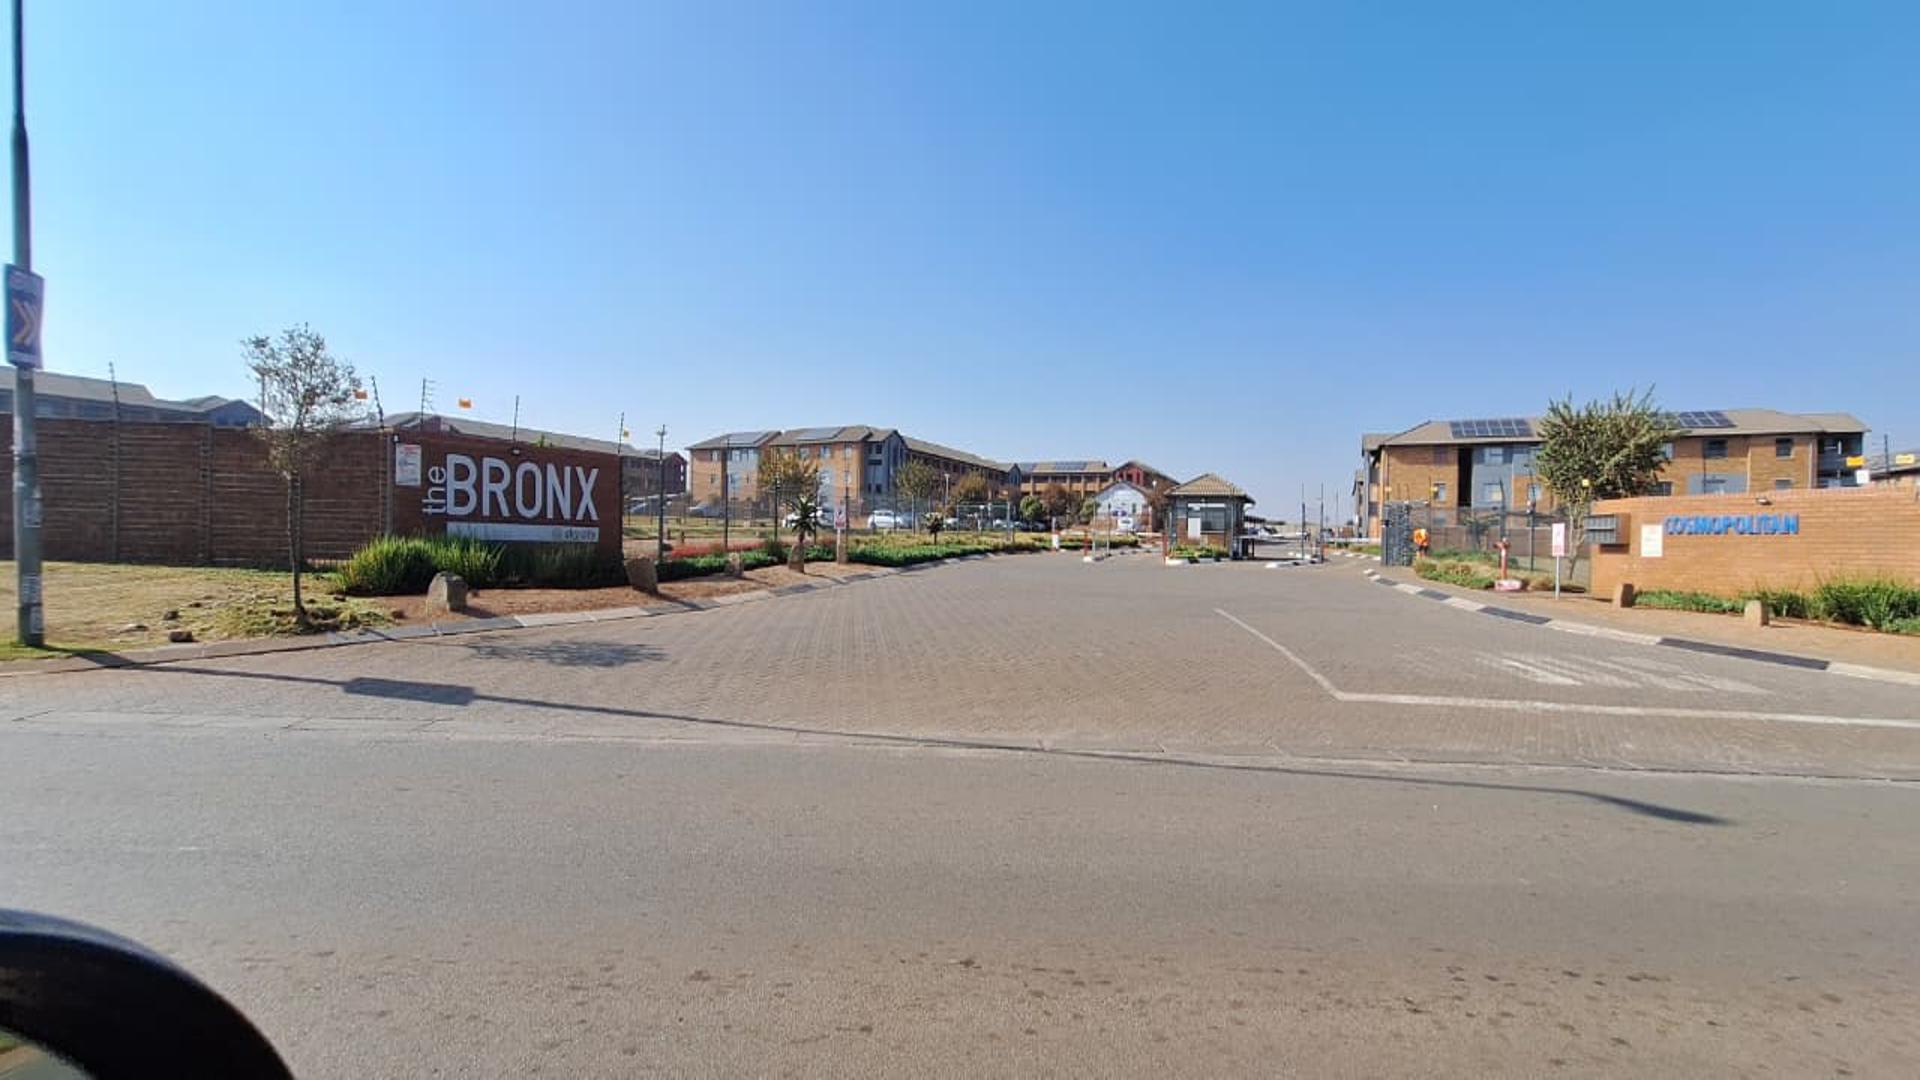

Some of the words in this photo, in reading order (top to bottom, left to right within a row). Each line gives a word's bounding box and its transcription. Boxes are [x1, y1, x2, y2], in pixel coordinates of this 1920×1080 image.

[421, 465, 447, 515] the
[446, 453, 600, 521] BRONX
[1664, 513, 1800, 535] COSMOPOLITAN
